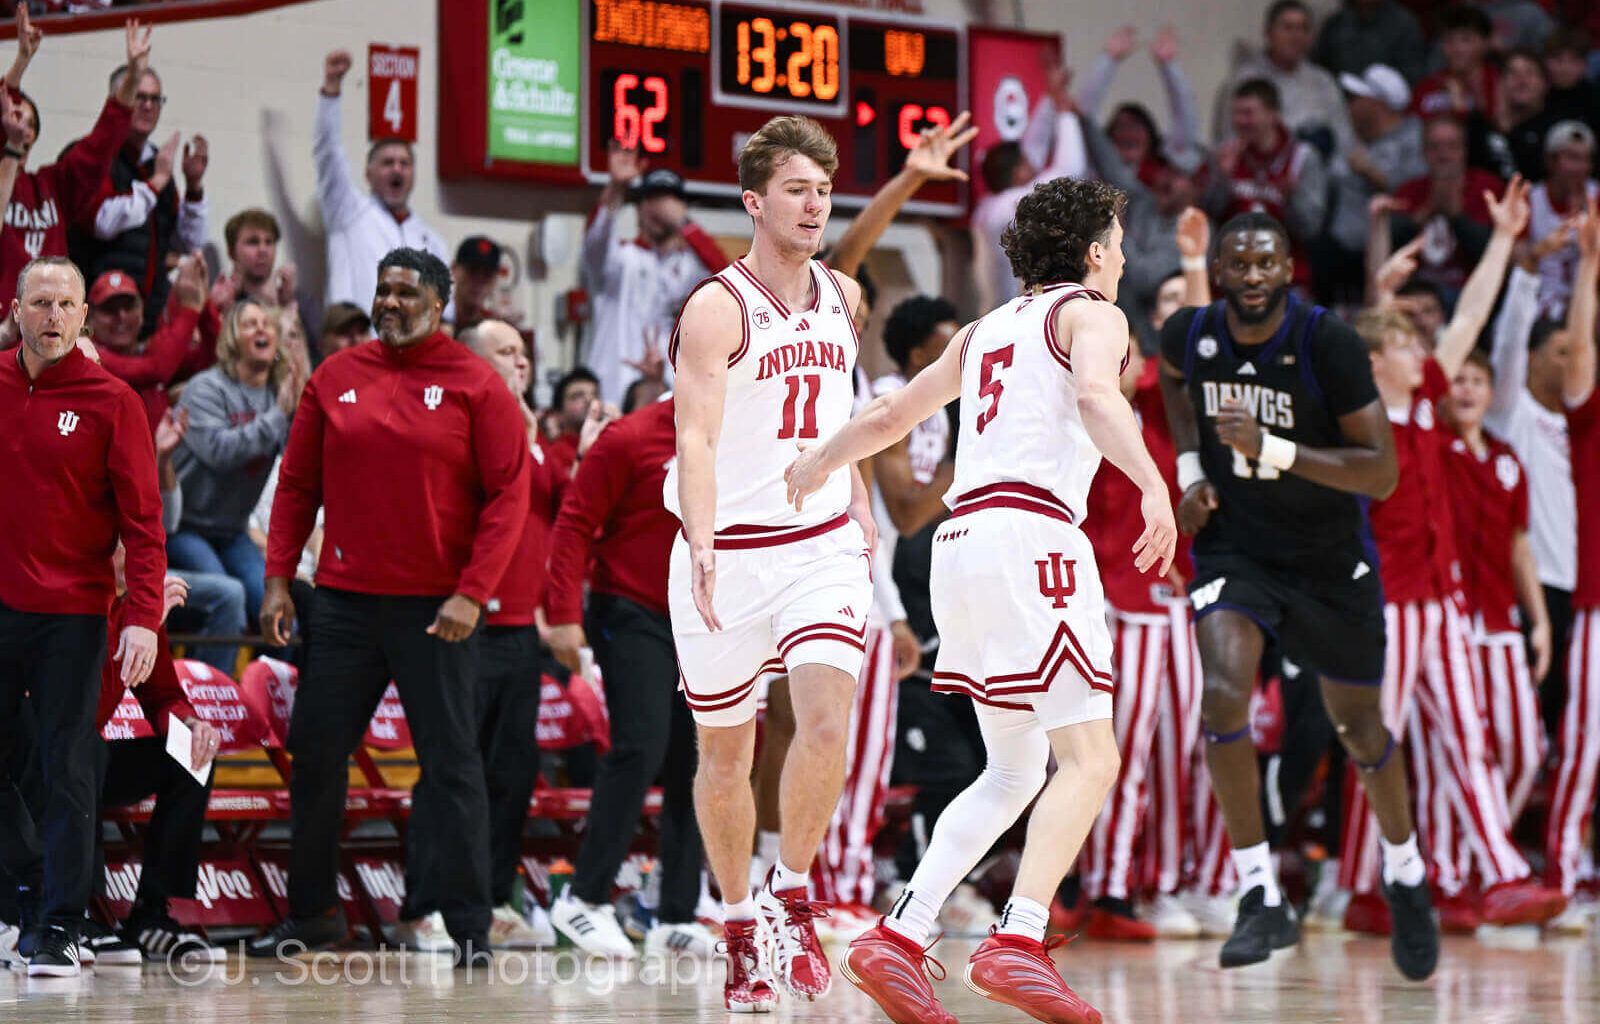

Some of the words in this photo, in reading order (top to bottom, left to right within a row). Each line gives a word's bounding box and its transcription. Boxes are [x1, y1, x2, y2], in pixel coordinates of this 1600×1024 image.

[370, 52, 416, 78] SECTION
[736, 17, 840, 100] 13:20
[383, 79, 403, 133] 4
[614, 74, 669, 153] 62
[755, 340, 846, 381] INDIANA
[777, 374, 821, 439] 11
[976, 343, 1015, 435] 5
[1202, 381, 1295, 429] DAWGS
[181, 679, 239, 701] German
[193, 702, 249, 720] merican
